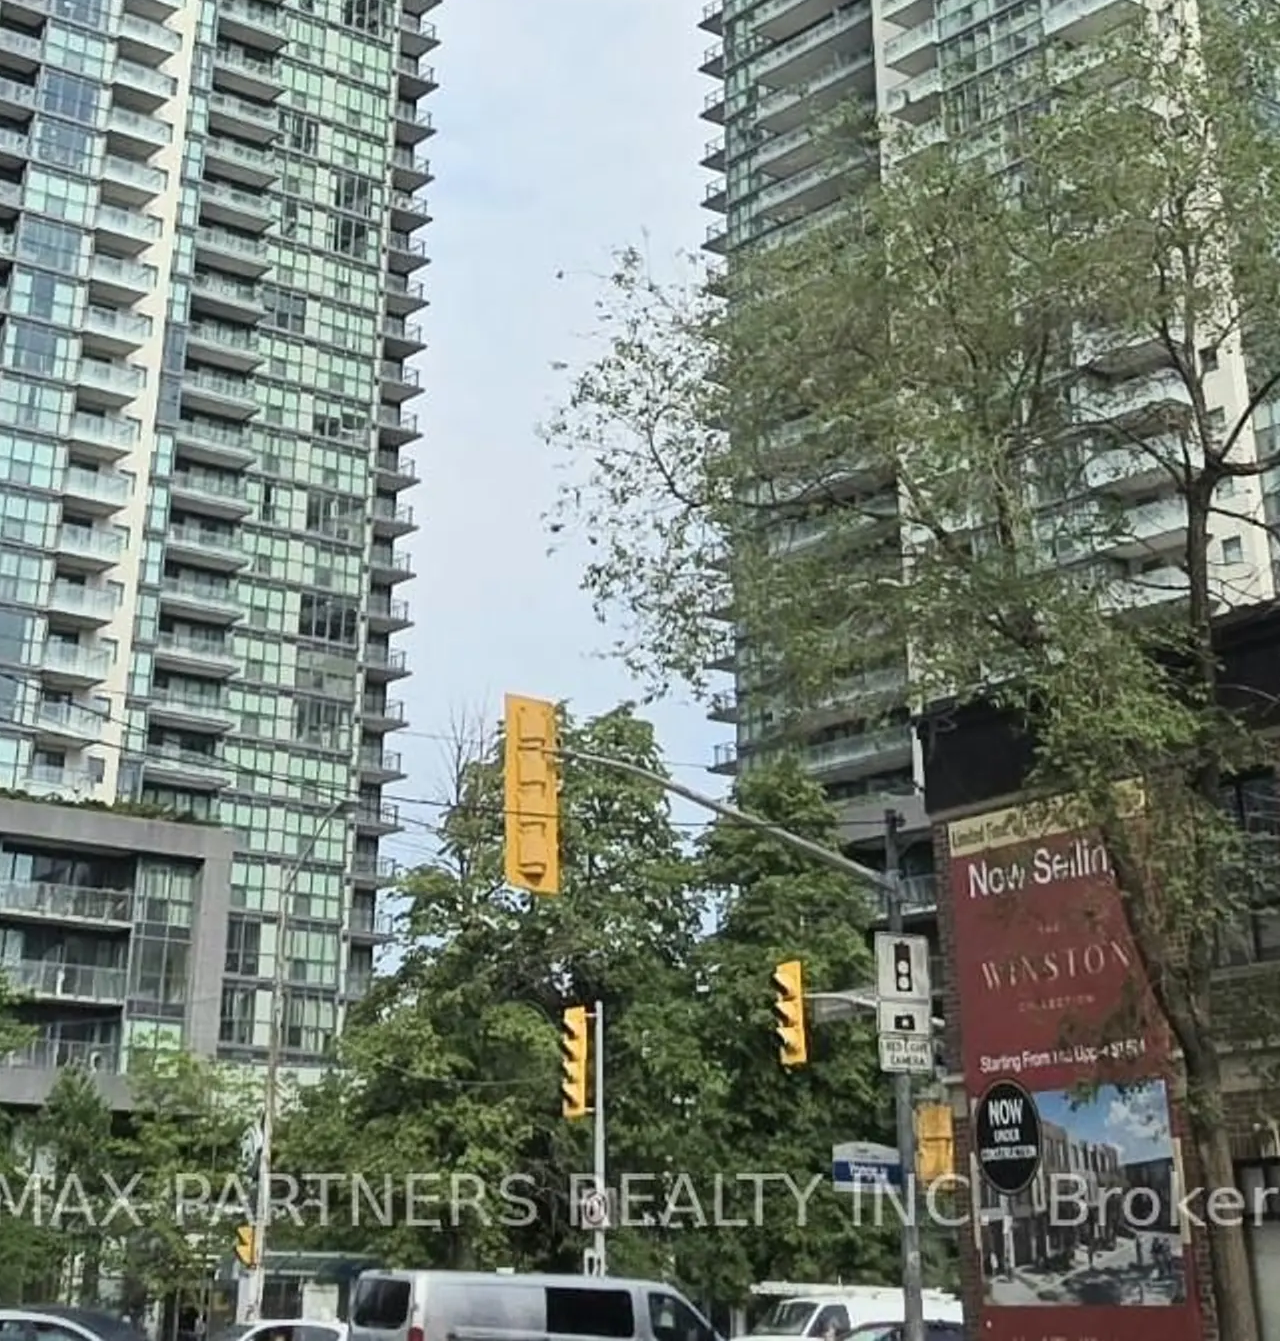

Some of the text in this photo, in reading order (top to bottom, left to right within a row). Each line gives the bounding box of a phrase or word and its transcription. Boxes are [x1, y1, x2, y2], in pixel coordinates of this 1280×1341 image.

[968, 861, 1025, 898] Now
[982, 940, 1132, 990] WINSTON
[980, 1055, 1021, 1073] Starting
[1022, 1051, 1051, 1068] From
[988, 1099, 1023, 1126] NOW
[994, 1128, 1020, 1142] UNDER
[980, 1145, 1037, 1162] CONSTRUCTION
